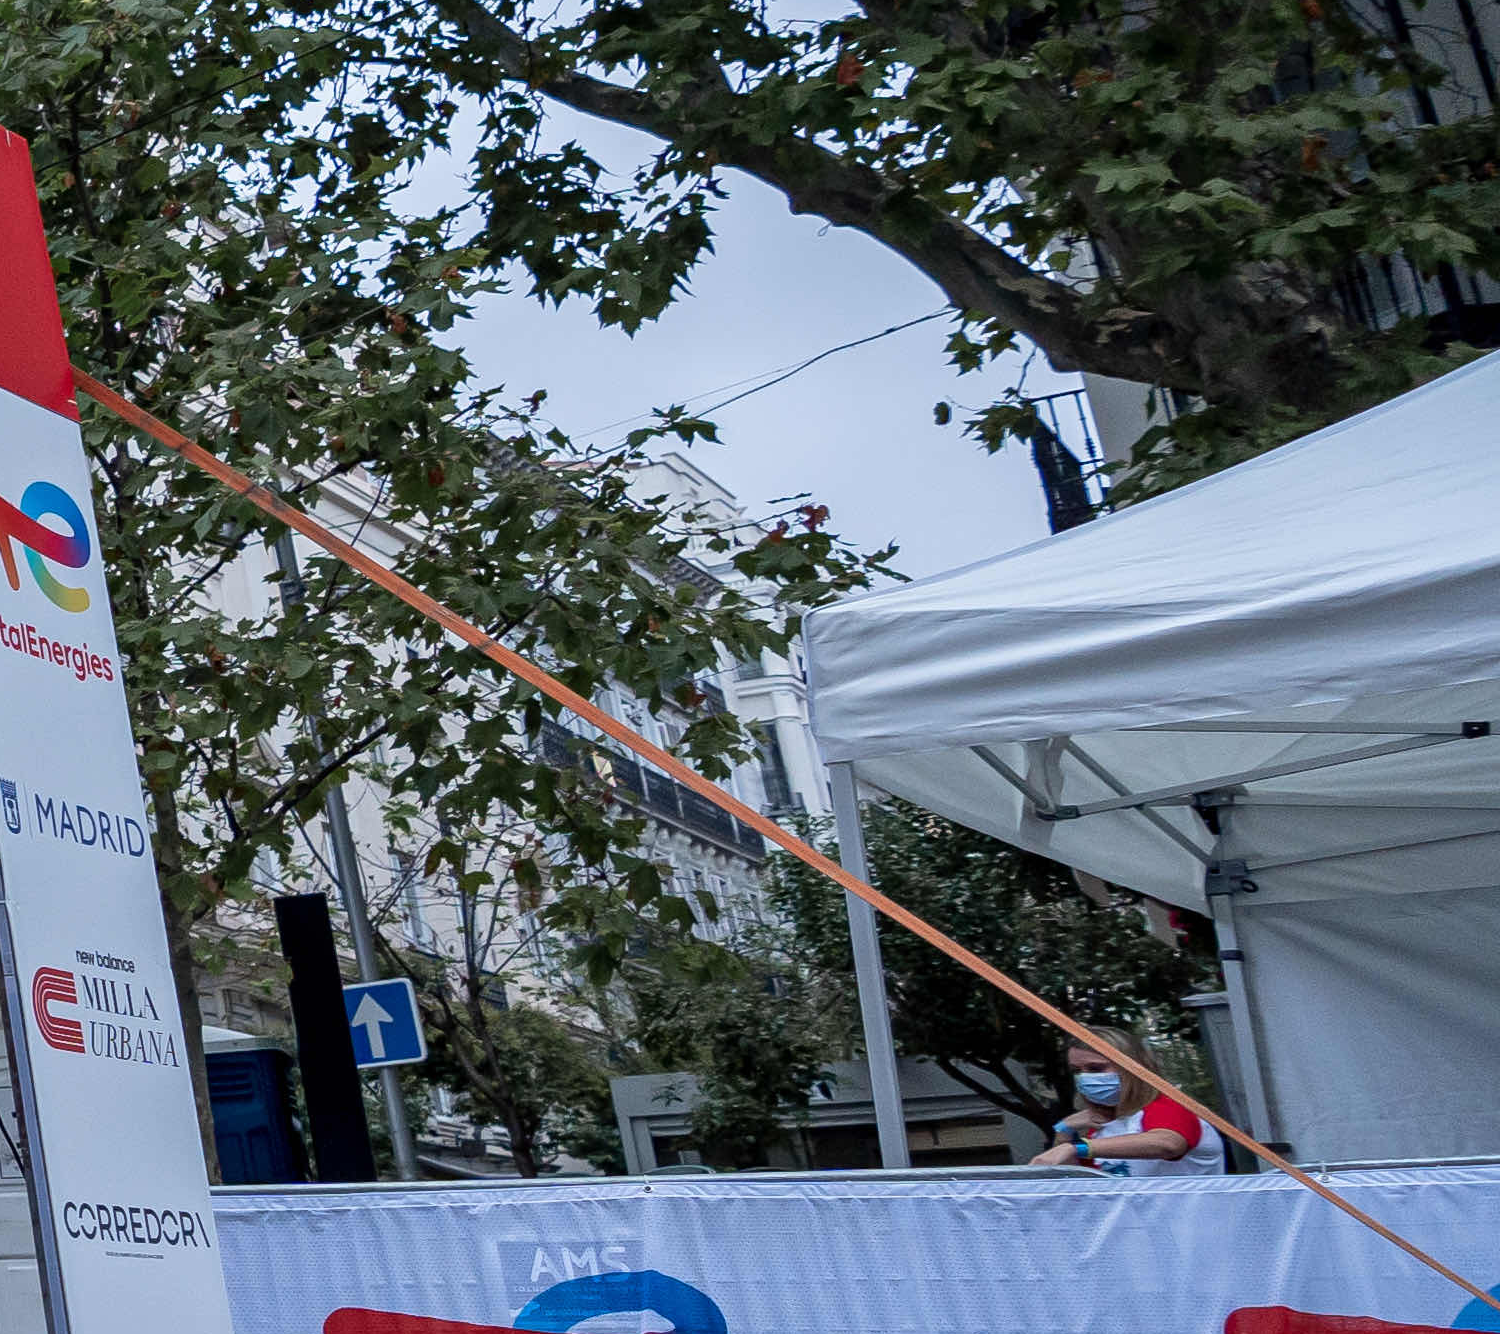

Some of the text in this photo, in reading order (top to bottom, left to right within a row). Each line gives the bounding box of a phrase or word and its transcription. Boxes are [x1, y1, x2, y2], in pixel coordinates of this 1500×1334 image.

[34, 792, 146, 858] MADRID
[75, 948, 135, 974] new balance
[81, 974, 161, 1022] MILLA
[89, 1020, 181, 1068] URBANA
